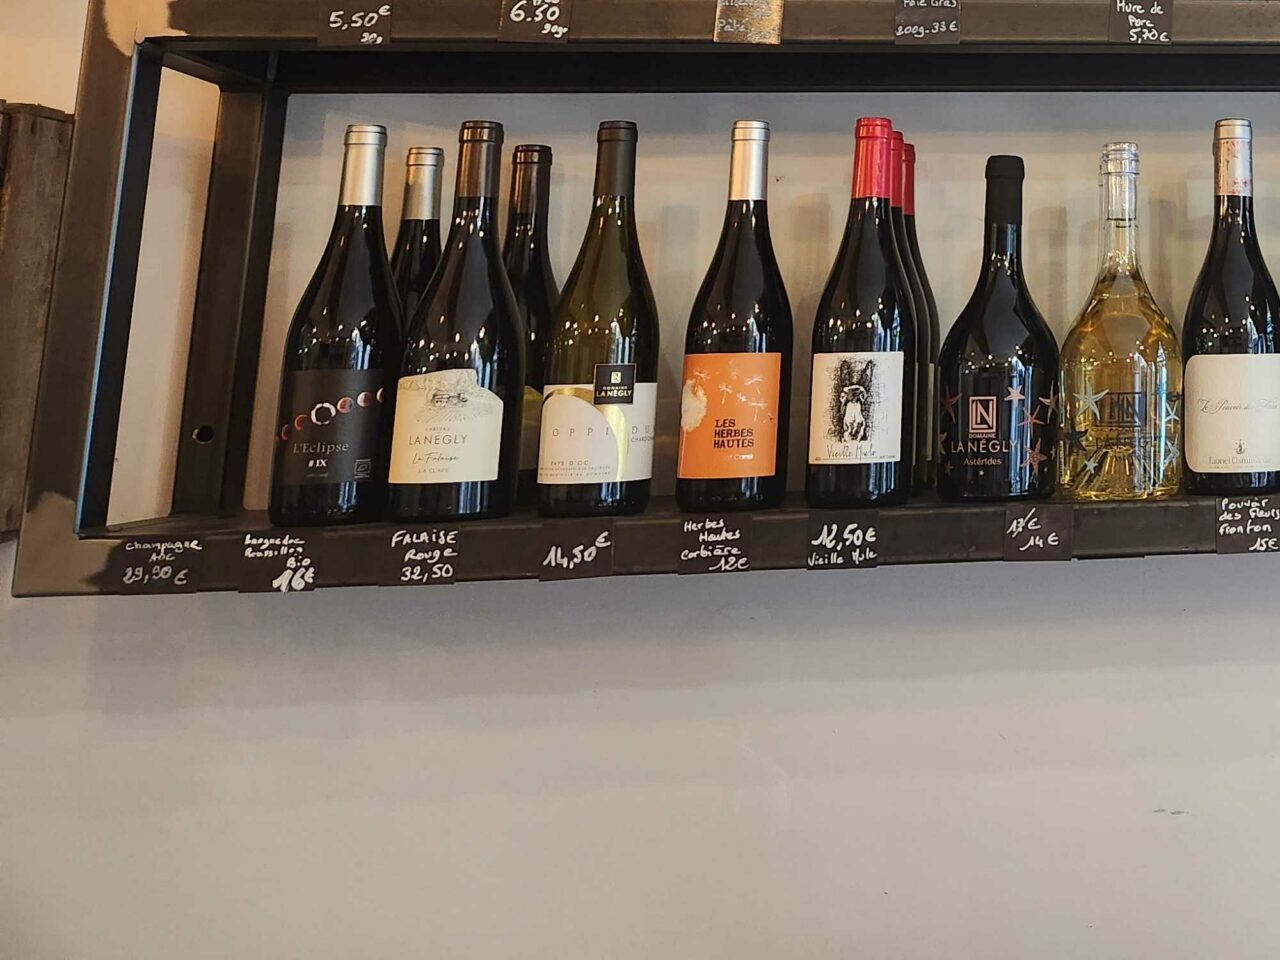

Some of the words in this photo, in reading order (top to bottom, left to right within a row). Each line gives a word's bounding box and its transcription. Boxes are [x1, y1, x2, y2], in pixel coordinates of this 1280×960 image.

[1116, 0, 1146, 14] Hure
[1150, 0, 1164, 14] de
[607, 389, 632, 398] NÉGLY
[715, 419, 736, 428] LES
[409, 434, 421, 445] LA
[424, 432, 468, 445] NÉGLY
[714, 428, 754, 438] HERBES
[293, 442, 349, 455] L'Eclipse
[713, 439, 754, 449] HAUTES
[951, 442, 964, 453] LA
[967, 439, 1019, 453] NÉGLY
[316, 459, 327, 467] IX
[1209, 456, 1230, 464] Lionel
[1221, 499, 1269, 510] Pouvoir
[1219, 510, 1242, 521] des
[1249, 508, 1280, 521] Fleurs
[684, 519, 725, 532] Herbes
[1219, 520, 1272, 535] Fronton
[699, 528, 741, 541] Hautes
[126, 540, 203, 558] champagne
[1249, 538, 1279, 551] 15€
[405, 548, 458, 564] Rouge
[808, 548, 843, 566] Vieille
[852, 551, 878, 564] Mule
[709, 556, 750, 571] 12€
[272, 568, 314, 593] 16€
[400, 565, 454, 583] 32,50
